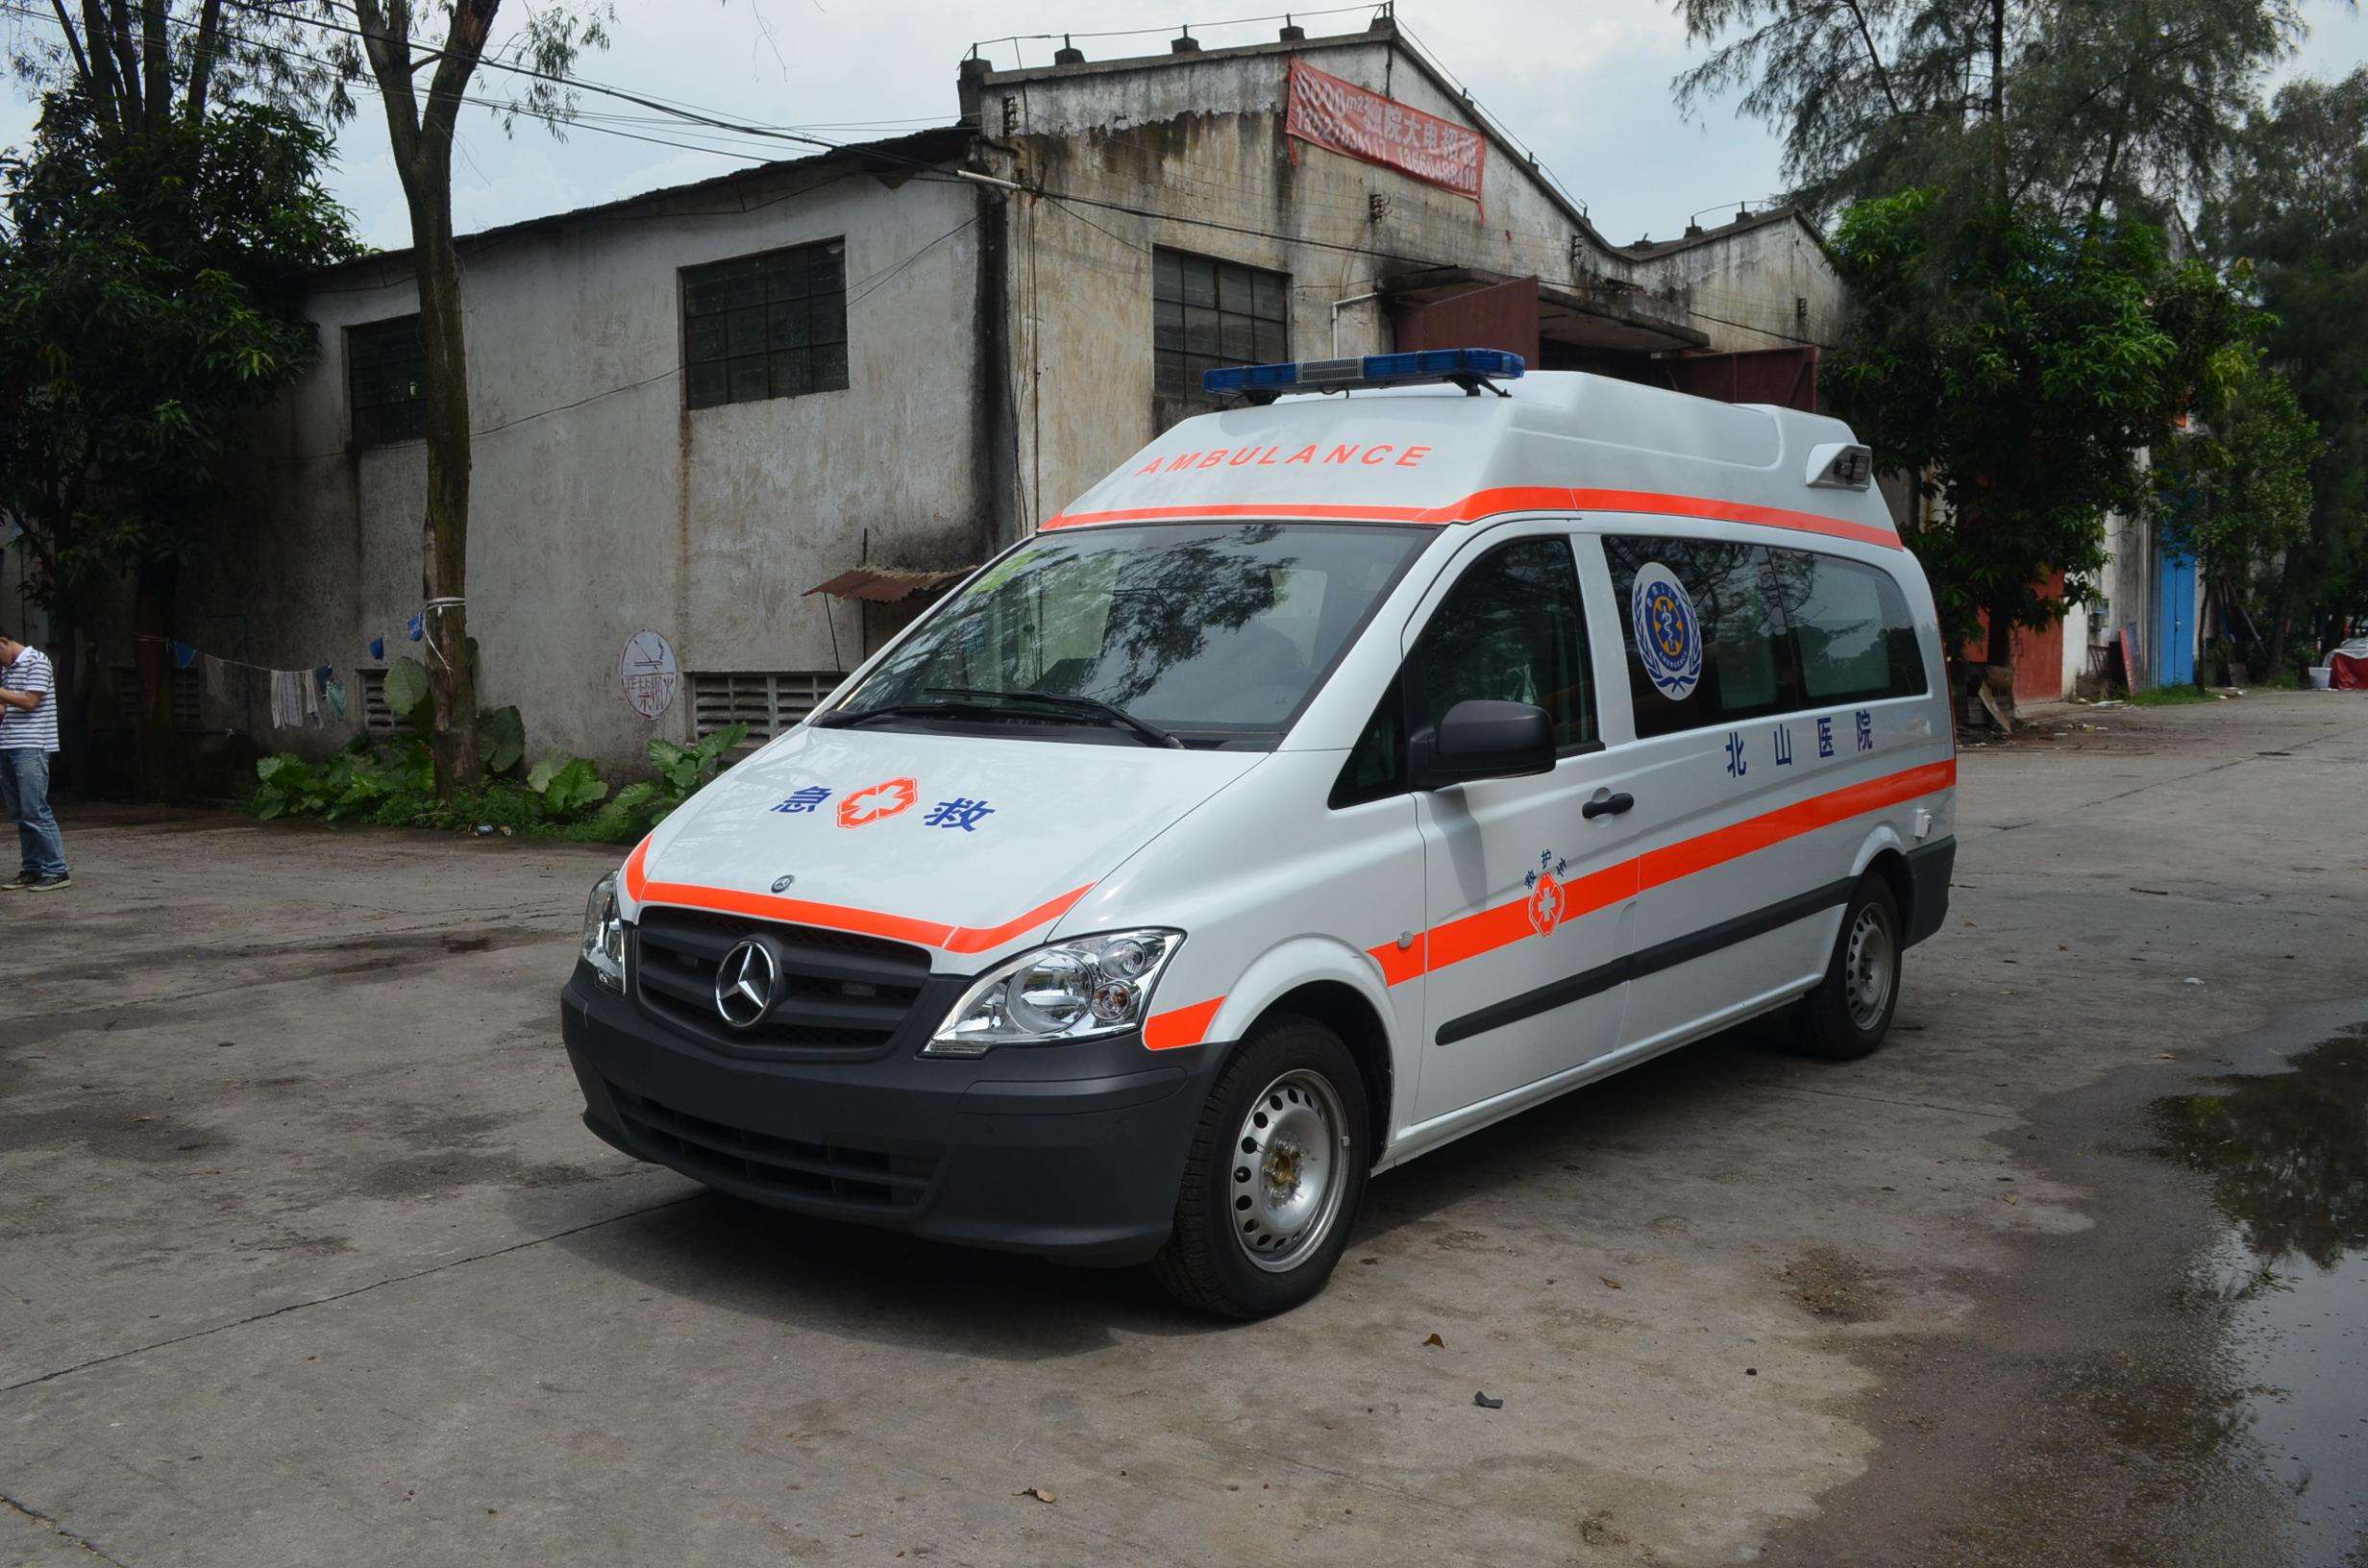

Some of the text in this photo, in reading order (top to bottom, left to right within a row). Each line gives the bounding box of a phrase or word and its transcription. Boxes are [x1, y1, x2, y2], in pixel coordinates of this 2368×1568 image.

[1134, 443, 1433, 477] AMBULANCE
[1725, 710, 1873, 778] 北山医院
